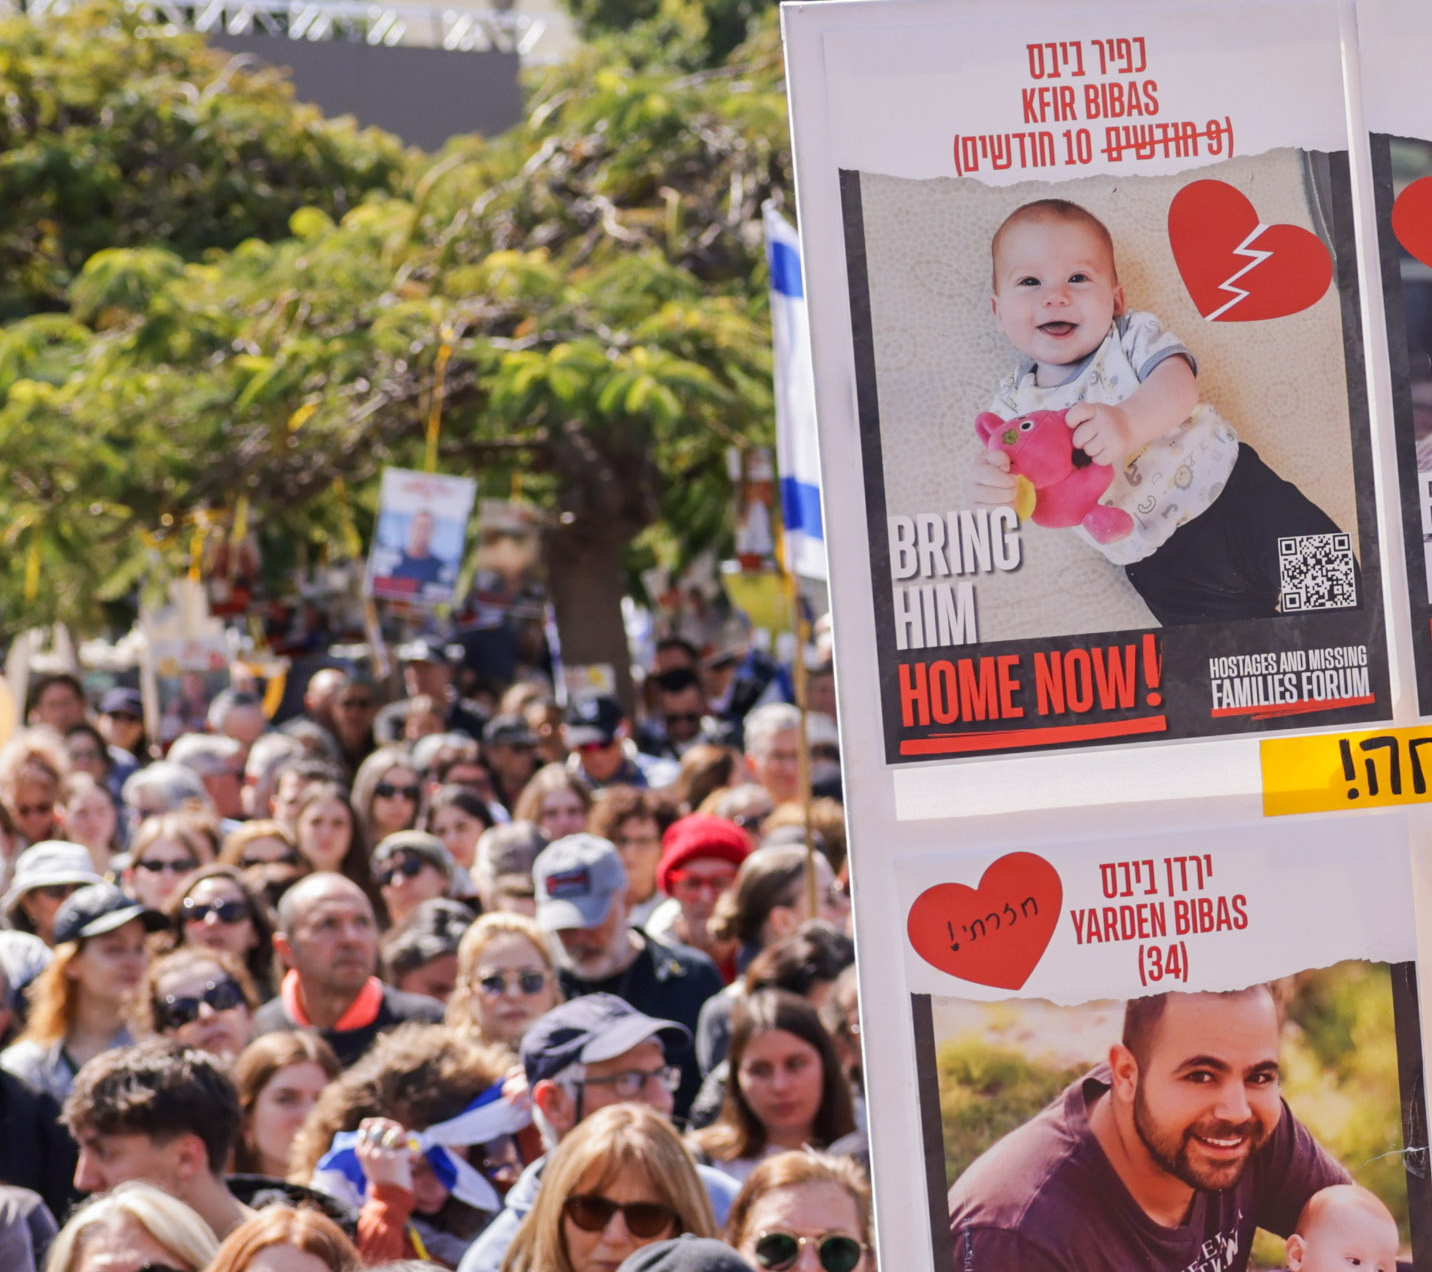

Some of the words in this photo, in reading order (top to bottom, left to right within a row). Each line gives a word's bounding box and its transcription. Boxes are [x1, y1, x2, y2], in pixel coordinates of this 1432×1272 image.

[1026, 41, 1086, 80] ביבס
[1091, 37, 1147, 75] כפיר
[1021, 85, 1078, 124] KFIR
[1083, 79, 1160, 120] BIBAS
[1062, 128, 1093, 165] 10
[889, 504, 1022, 579] BRING
[893, 580, 981, 651] HIM
[898, 653, 1025, 728] HOME
[1034, 632, 1164, 716] NOW!
[1208, 651, 1276, 679] HOSTAGES
[1279, 648, 1306, 673] AND
[1307, 644, 1368, 670] MISSING
[1210, 670, 1299, 710] FAMILIES
[1300, 666, 1371, 703] FORUM
[1099, 860, 1158, 899] ביבס
[1164, 854, 1213, 897] ירדן
[1070, 901, 1167, 945] YARDEN
[1173, 894, 1249, 936] BIBAS
[1138, 941, 1189, 987] (34)
